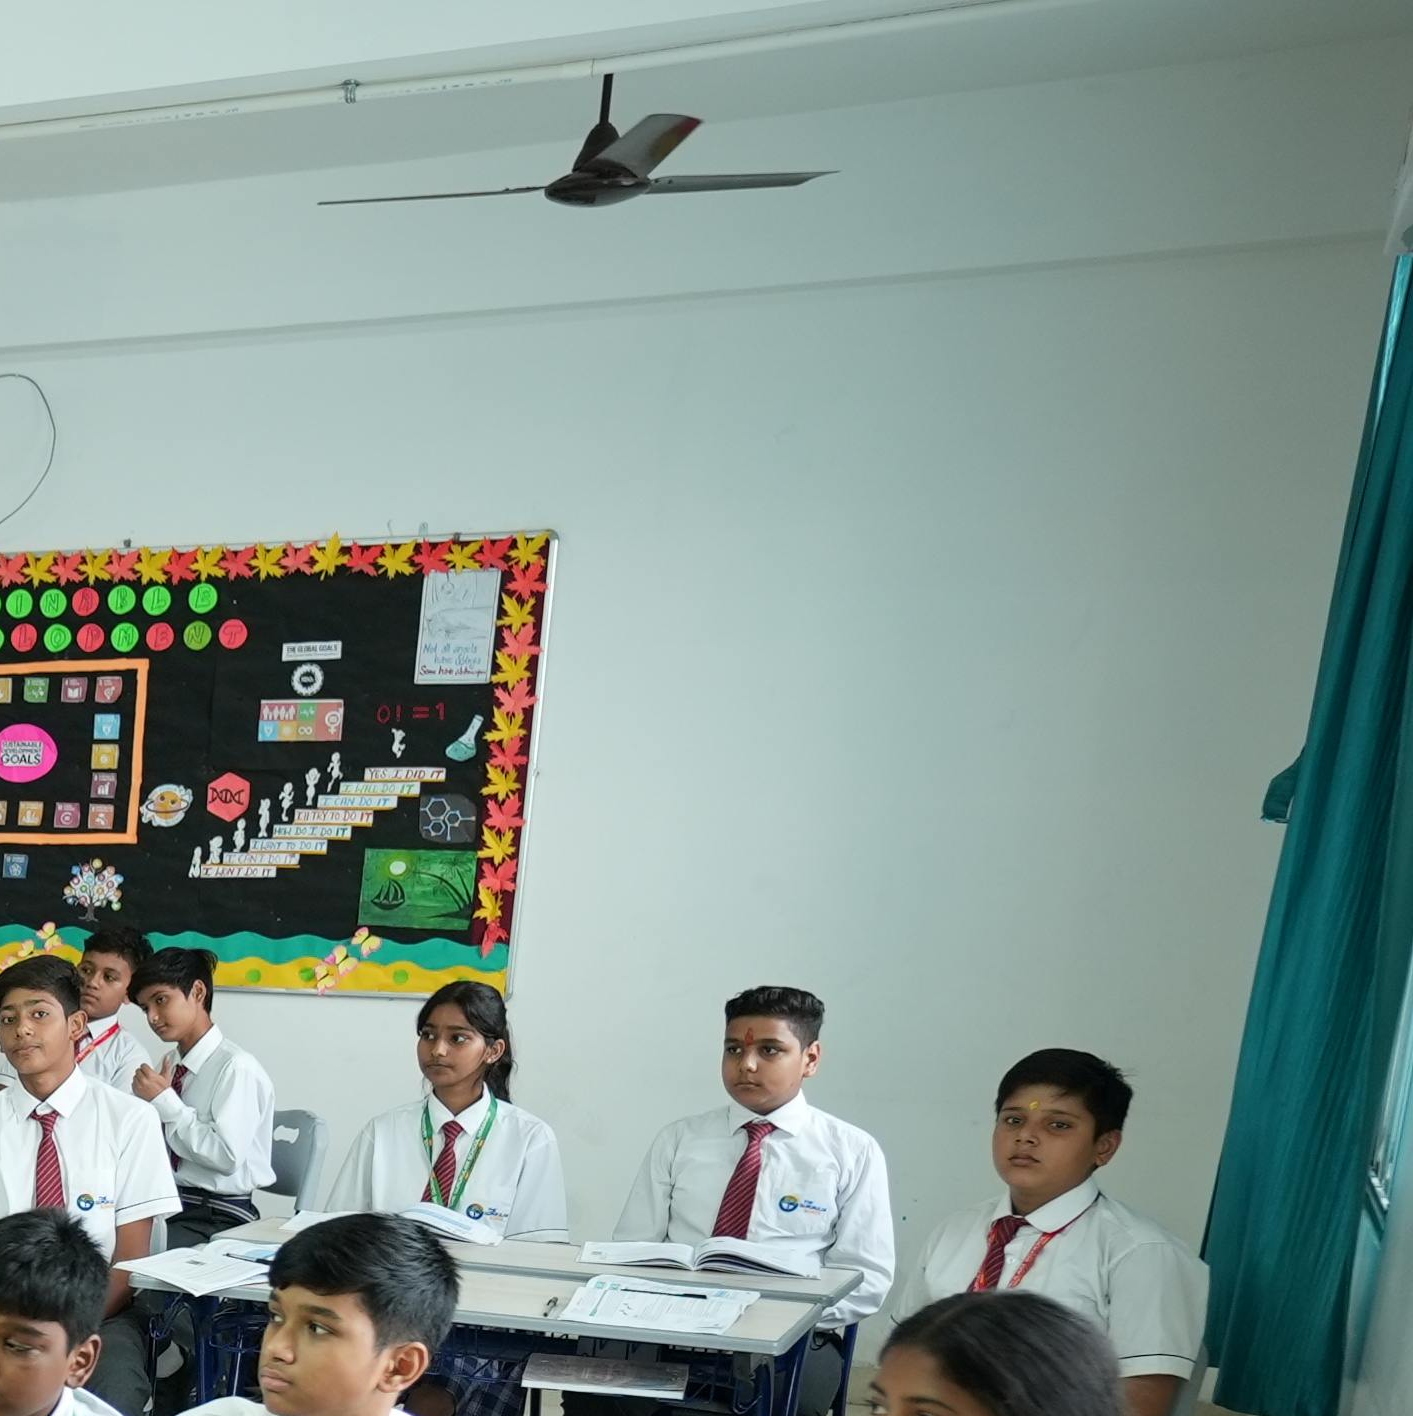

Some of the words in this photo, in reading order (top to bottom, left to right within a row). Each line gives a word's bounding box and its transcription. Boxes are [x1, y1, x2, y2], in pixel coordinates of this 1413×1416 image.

[1, 753, 41, 765] GOALS
[405, 769, 426, 779] DID
[430, 770, 444, 779] IT
[381, 784, 396, 793] DO
[399, 784, 415, 794] IT
[334, 797, 355, 806] CAN
[359, 797, 373, 806] DO
[376, 798, 390, 806] IT
[330, 811, 341, 820] TO
[343, 811, 357, 821] DO
[360, 812, 373, 822] IT
[295, 827, 307, 836] DO
[320, 828, 333, 837] DO
[336, 828, 348, 837] IT
[286, 841, 296, 850] TO
[299, 841, 312, 850] DO
[315, 841, 325, 851] IT
[245, 867, 259, 877] DO
[261, 868, 273, 877] IT
